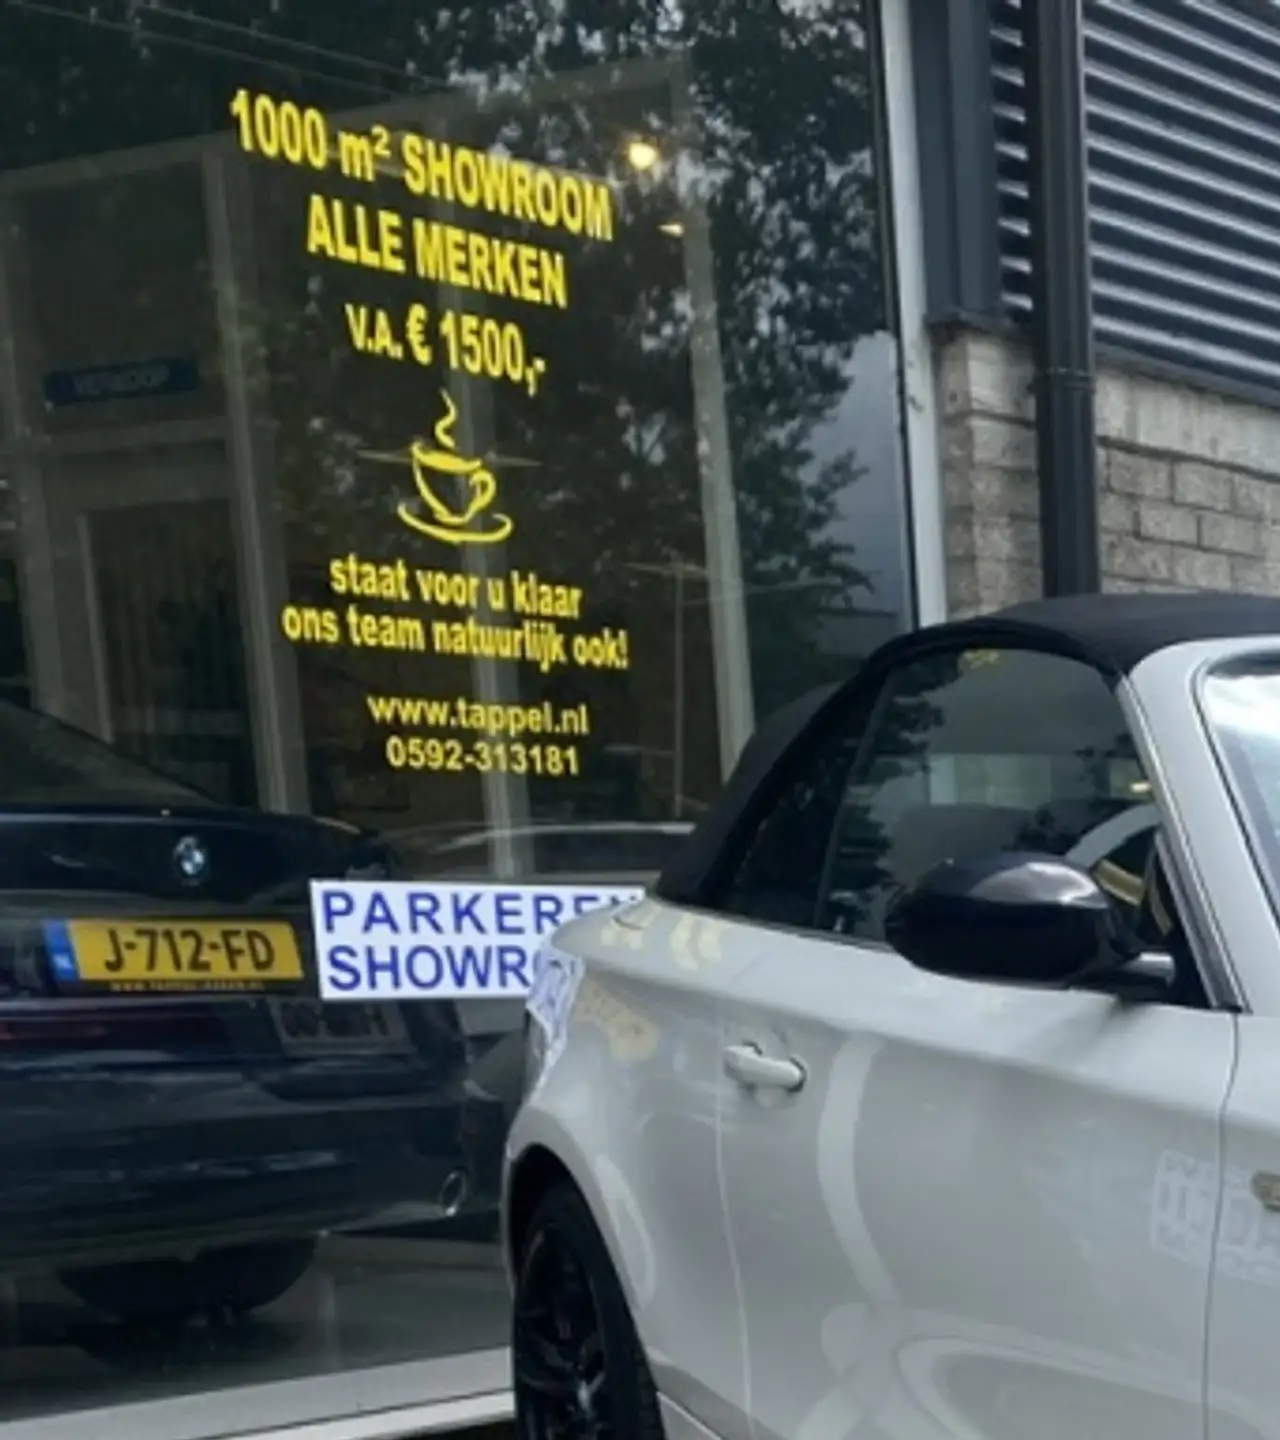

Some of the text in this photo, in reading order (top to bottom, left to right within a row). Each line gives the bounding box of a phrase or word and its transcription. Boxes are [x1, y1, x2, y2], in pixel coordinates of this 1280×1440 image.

[231, 88, 328, 169] 1000
[402, 132, 613, 242] SHOWROOM
[308, 194, 568, 309] ALLE MERKEN
[345, 303, 546, 397] V.A. € 1500,-
[330, 553, 583, 618] staat voor u klaar
[282, 606, 629, 672] ons team natuurlijk ook!
[366, 695, 589, 736] www.tappel.nl
[386, 735, 579, 775] 0592-313181
[322, 890, 638, 935] PARKER
[105, 928, 275, 972] J-712-FD
[328, 945, 541, 990] SHOWR
